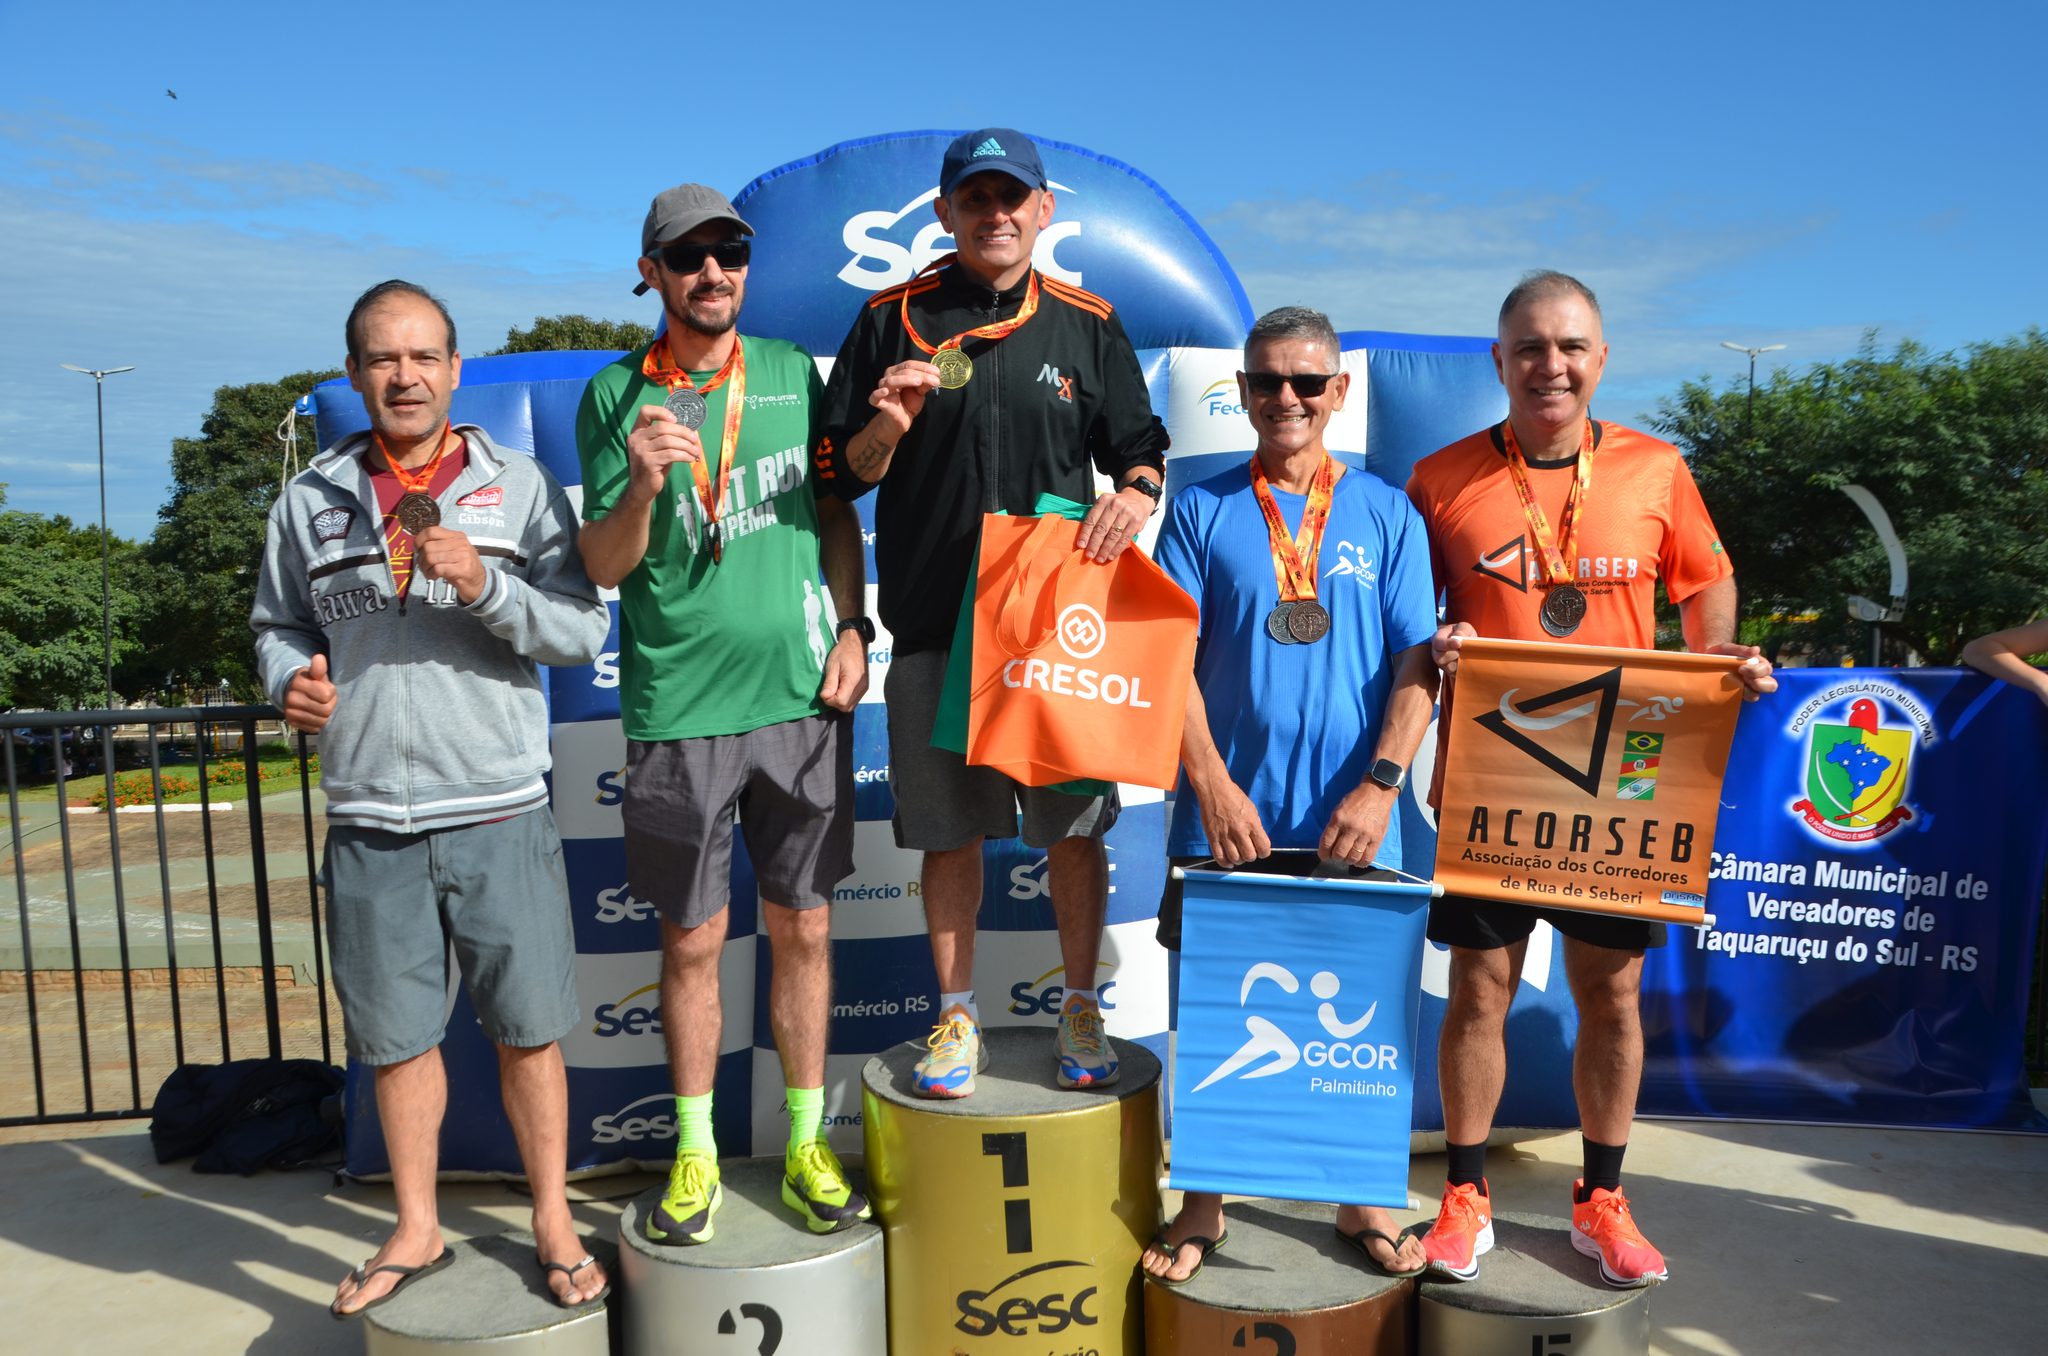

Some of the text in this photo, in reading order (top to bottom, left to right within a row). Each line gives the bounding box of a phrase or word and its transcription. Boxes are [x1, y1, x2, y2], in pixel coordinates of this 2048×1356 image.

[973, 149, 1007, 158] adidas
[836, 210, 1083, 290] Sec
[459, 513, 504, 527] Gibson
[1355, 566, 1376, 582] GCOR
[1529, 556, 1638, 580] ARSEB
[1002, 657, 1152, 710] CRESOL
[1791, 684, 1935, 744] PODER LEGISLATIVO MUNICIPAL
[1467, 806, 1695, 863] ACORSEB
[1461, 848, 1688, 885] Associação dos Corredores
[1708, 852, 1989, 901] Câmara Municipal de
[906, 881, 922, 897] R
[1500, 875, 1643, 905] de Rua de Seberi
[1747, 891, 1935, 932] Vereadores de
[1695, 924, 1828, 964] Taquaruçu
[1835, 936, 1868, 962] do
[1875, 939, 1918, 967] Sul
[1941, 945, 1978, 972] RS
[905, 995, 930, 1013] RS
[1008, 981, 1116, 1016] Sec
[1303, 1040, 1398, 1070] GCOR
[1310, 1077, 1397, 1097] Palmitinho
[592, 1114, 679, 1143] Ses
[982, 1131, 1033, 1254] 1
[954, 1284, 1099, 1336] Sesc
